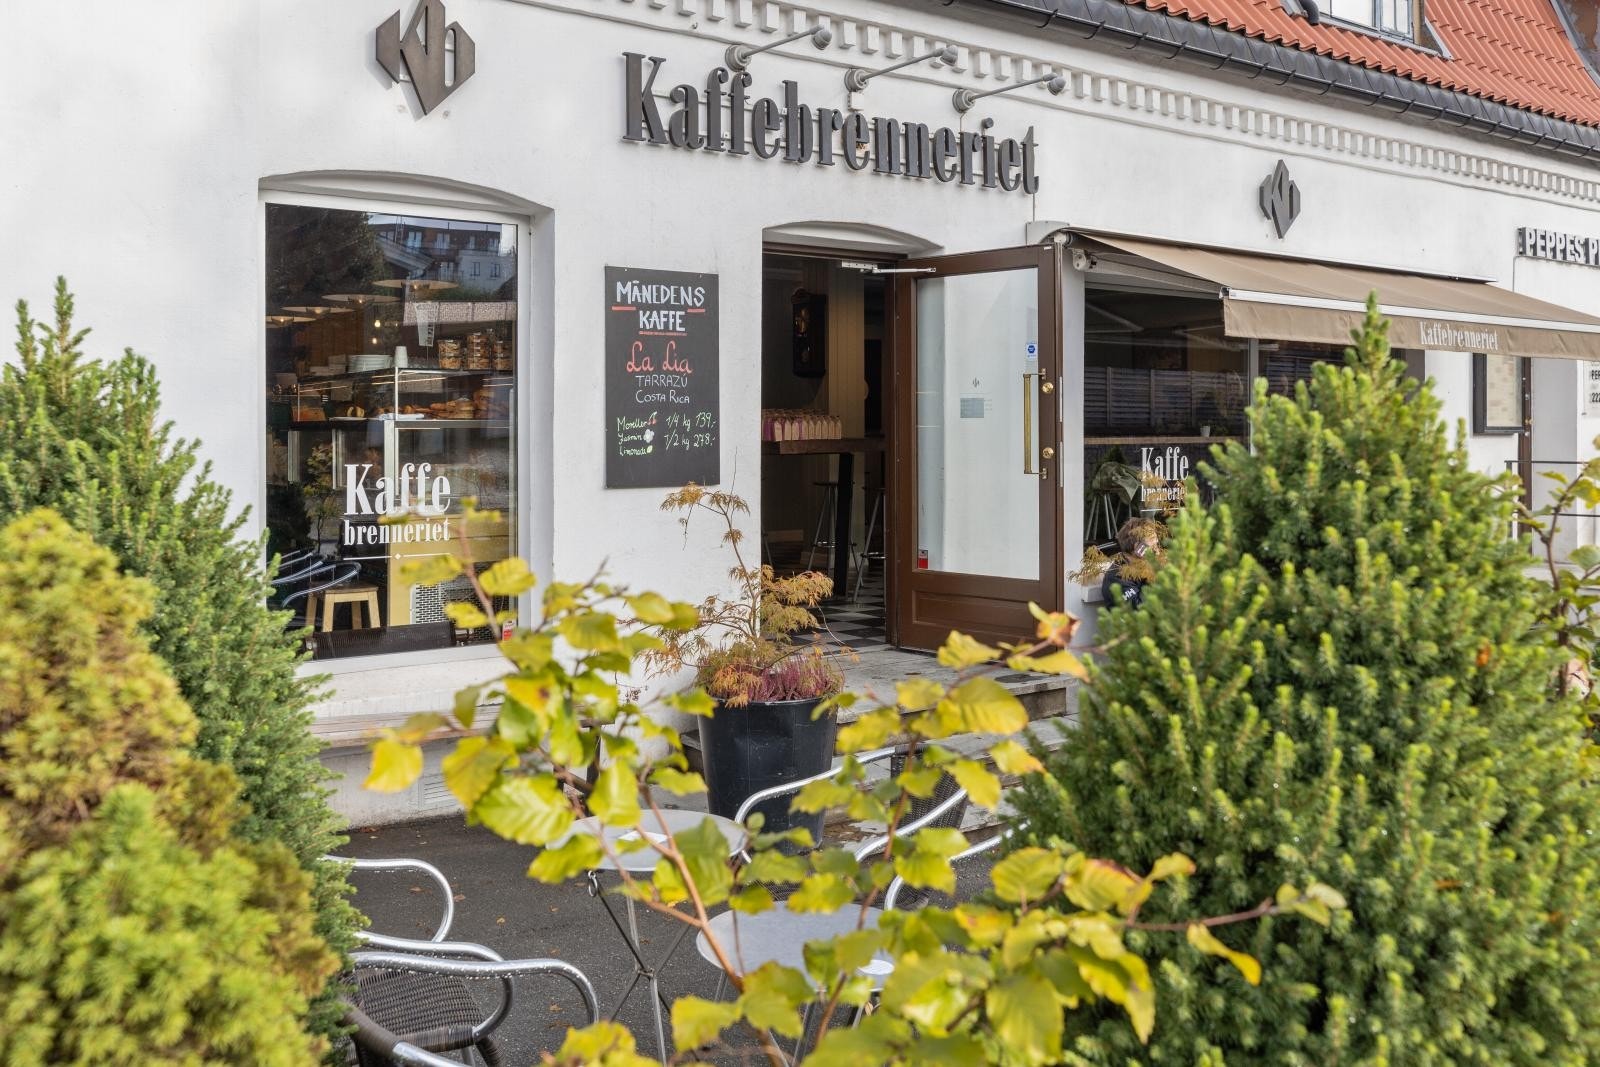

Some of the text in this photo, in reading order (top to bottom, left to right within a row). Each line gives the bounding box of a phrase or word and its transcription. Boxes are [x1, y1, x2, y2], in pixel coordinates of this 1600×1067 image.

[622, 51, 1039, 195] Kaffebrenneriet
[1520, 226, 1587, 263] PEPPES
[616, 279, 706, 307] MÅNEDENS
[639, 310, 686, 332] KAFFE
[1420, 321, 1498, 351] Kaffebrenneriet
[626, 340, 693, 374] La Lia
[665, 412, 679, 429] 1/4
[682, 413, 691, 432] kg
[663, 429, 680, 451] 1/2
[681, 433, 690, 451] kg
[1141, 446, 1189, 481] Kaffe
[344, 462, 451, 516] Kaffe
[343, 517, 451, 546] brenneriet
